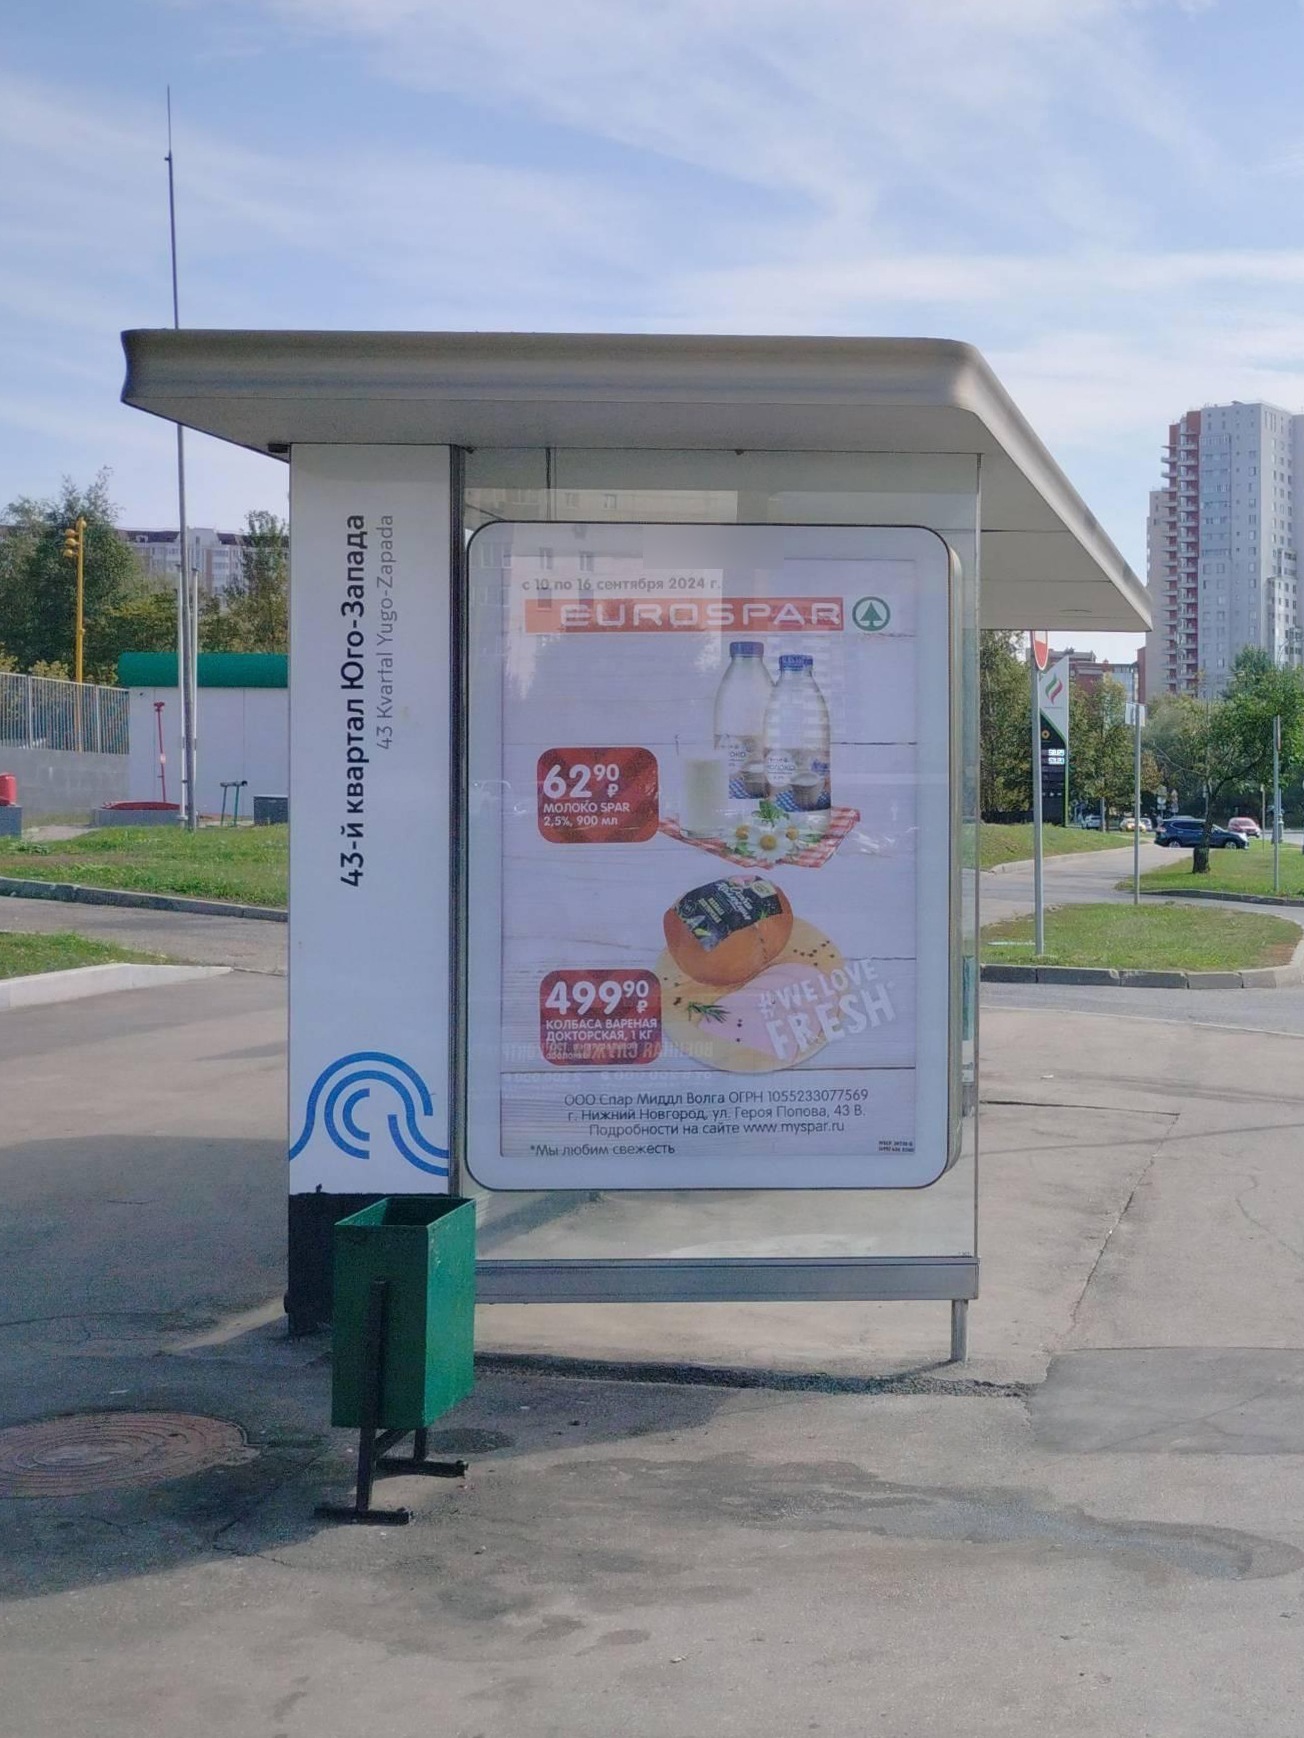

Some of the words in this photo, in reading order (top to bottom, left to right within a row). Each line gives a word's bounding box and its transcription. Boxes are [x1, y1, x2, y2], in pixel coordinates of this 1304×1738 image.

[376, 514, 398, 646] Yugo-Zapada
[521, 579, 530, 591] с
[535, 578, 550, 591] 10
[554, 580, 572, 591] по
[577, 578, 592, 591] 16
[596, 577, 664, 593] сентября
[668, 576, 705, 590] 2024
[710, 579, 721, 590] г.
[340, 514, 368, 690] Юго-Запада
[560, 602, 841, 628] EUROSPAR
[376, 652, 394, 719] Kvartal
[376, 726, 393, 750] 43
[346, 699, 369, 814] квартал
[543, 764, 593, 799] 62
[543, 802, 598, 814] МОЛОКО
[600, 802, 630, 813] SPAR
[543, 815, 573, 828] 2,5%,
[576, 815, 598, 827] 900
[601, 817, 618, 826] мл
[340, 822, 364, 887] 43-й
[545, 980, 622, 1016] 499
[760, 980, 819, 1019] #WE
[818, 959, 879, 997] LOVE
[545, 1030, 628, 1042] ДОКТОРСКАЯ,
[639, 1029, 653, 1041] КГ
[546, 1019, 602, 1031] КОЛБАСА
[605, 1018, 658, 1030] ВАРЕНАЯ
[564, 1093, 596, 1107] ООО
[600, 1093, 634, 1108] Спар
[636, 1092, 683, 1107] Миддл
[686, 1091, 725, 1105] Волга
[728, 1091, 764, 1104] ОГРН
[768, 1088, 869, 1103] 1055233077569
[581, 1108, 636, 1121] Нижний
[639, 1108, 708, 1122] Новгород,
[712, 1109, 731, 1122] ул.
[735, 1106, 773, 1121] Героя
[776, 1105, 830, 1119] Попова,
[833, 1104, 850, 1117] 43
[589, 1123, 679, 1138] Подробности
[682, 1124, 699, 1135] на
[702, 1121, 740, 1135] сайте
[743, 1120, 845, 1136] www.myspar.ru
[561, 1143, 609, 1157] любим
[612, 1143, 676, 1156] свежесть
